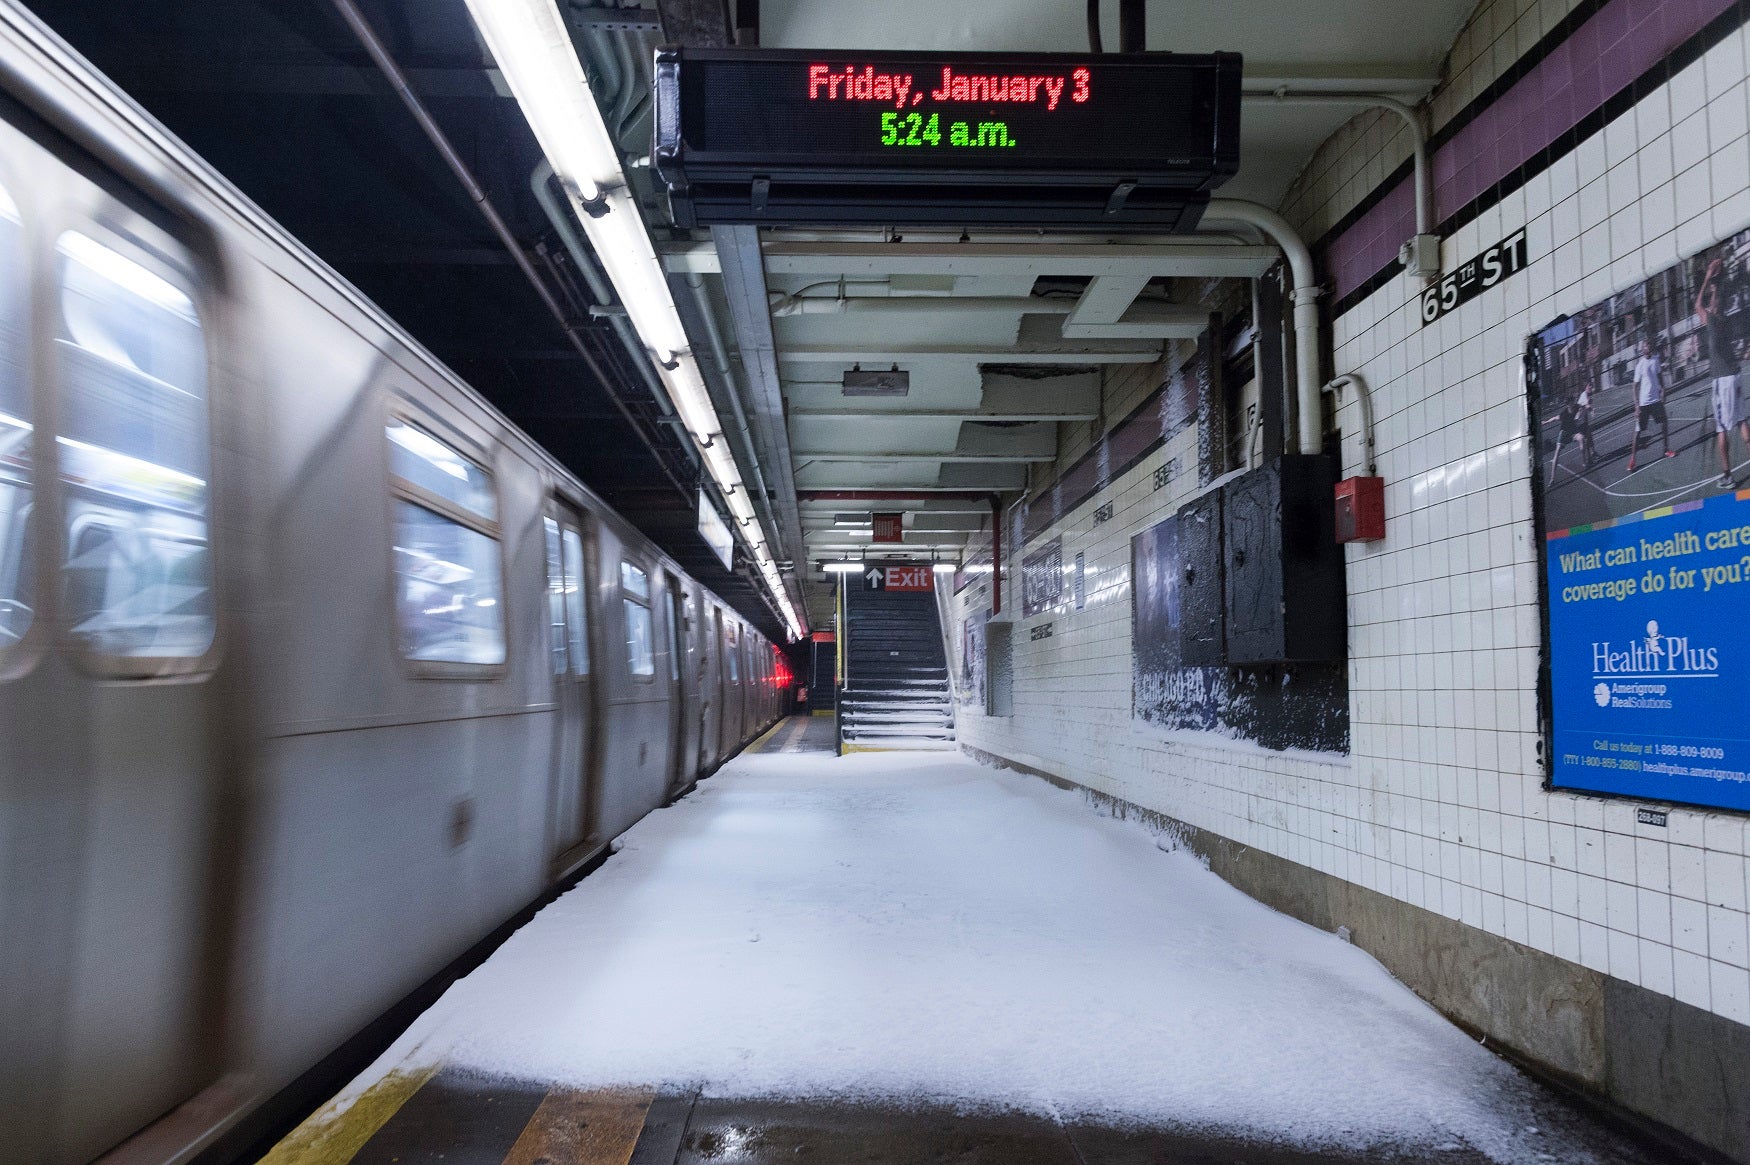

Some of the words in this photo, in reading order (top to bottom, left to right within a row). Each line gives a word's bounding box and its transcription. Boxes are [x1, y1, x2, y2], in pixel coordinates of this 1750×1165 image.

[809, 65, 924, 108] Friday,
[931, 66, 1066, 111] January
[1072, 67, 1090, 103] 3
[880, 112, 941, 147] 5:24
[949, 118, 1017, 147] a.m.
[1481, 229, 1525, 287] ST
[1559, 549, 1602, 574] What
[1604, 546, 1637, 567] can
[1640, 531, 1701, 561] health
[1705, 525, 1750, 551] care
[885, 567, 928, 587] Exit
[1562, 578, 1637, 603] coverage
[1641, 570, 1665, 593] do
[1669, 566, 1697, 590] for
[1701, 556, 1750, 591] you?
[1611, 682, 1667, 696] Amerigroup
[1611, 697, 1673, 709] RealSolutions
[1563, 754, 1579, 765] (TTY
[1593, 739, 1609, 751] Call
[1609, 743, 1619, 752] us
[1620, 742, 1643, 756] today
[1643, 744, 1653, 754] at
